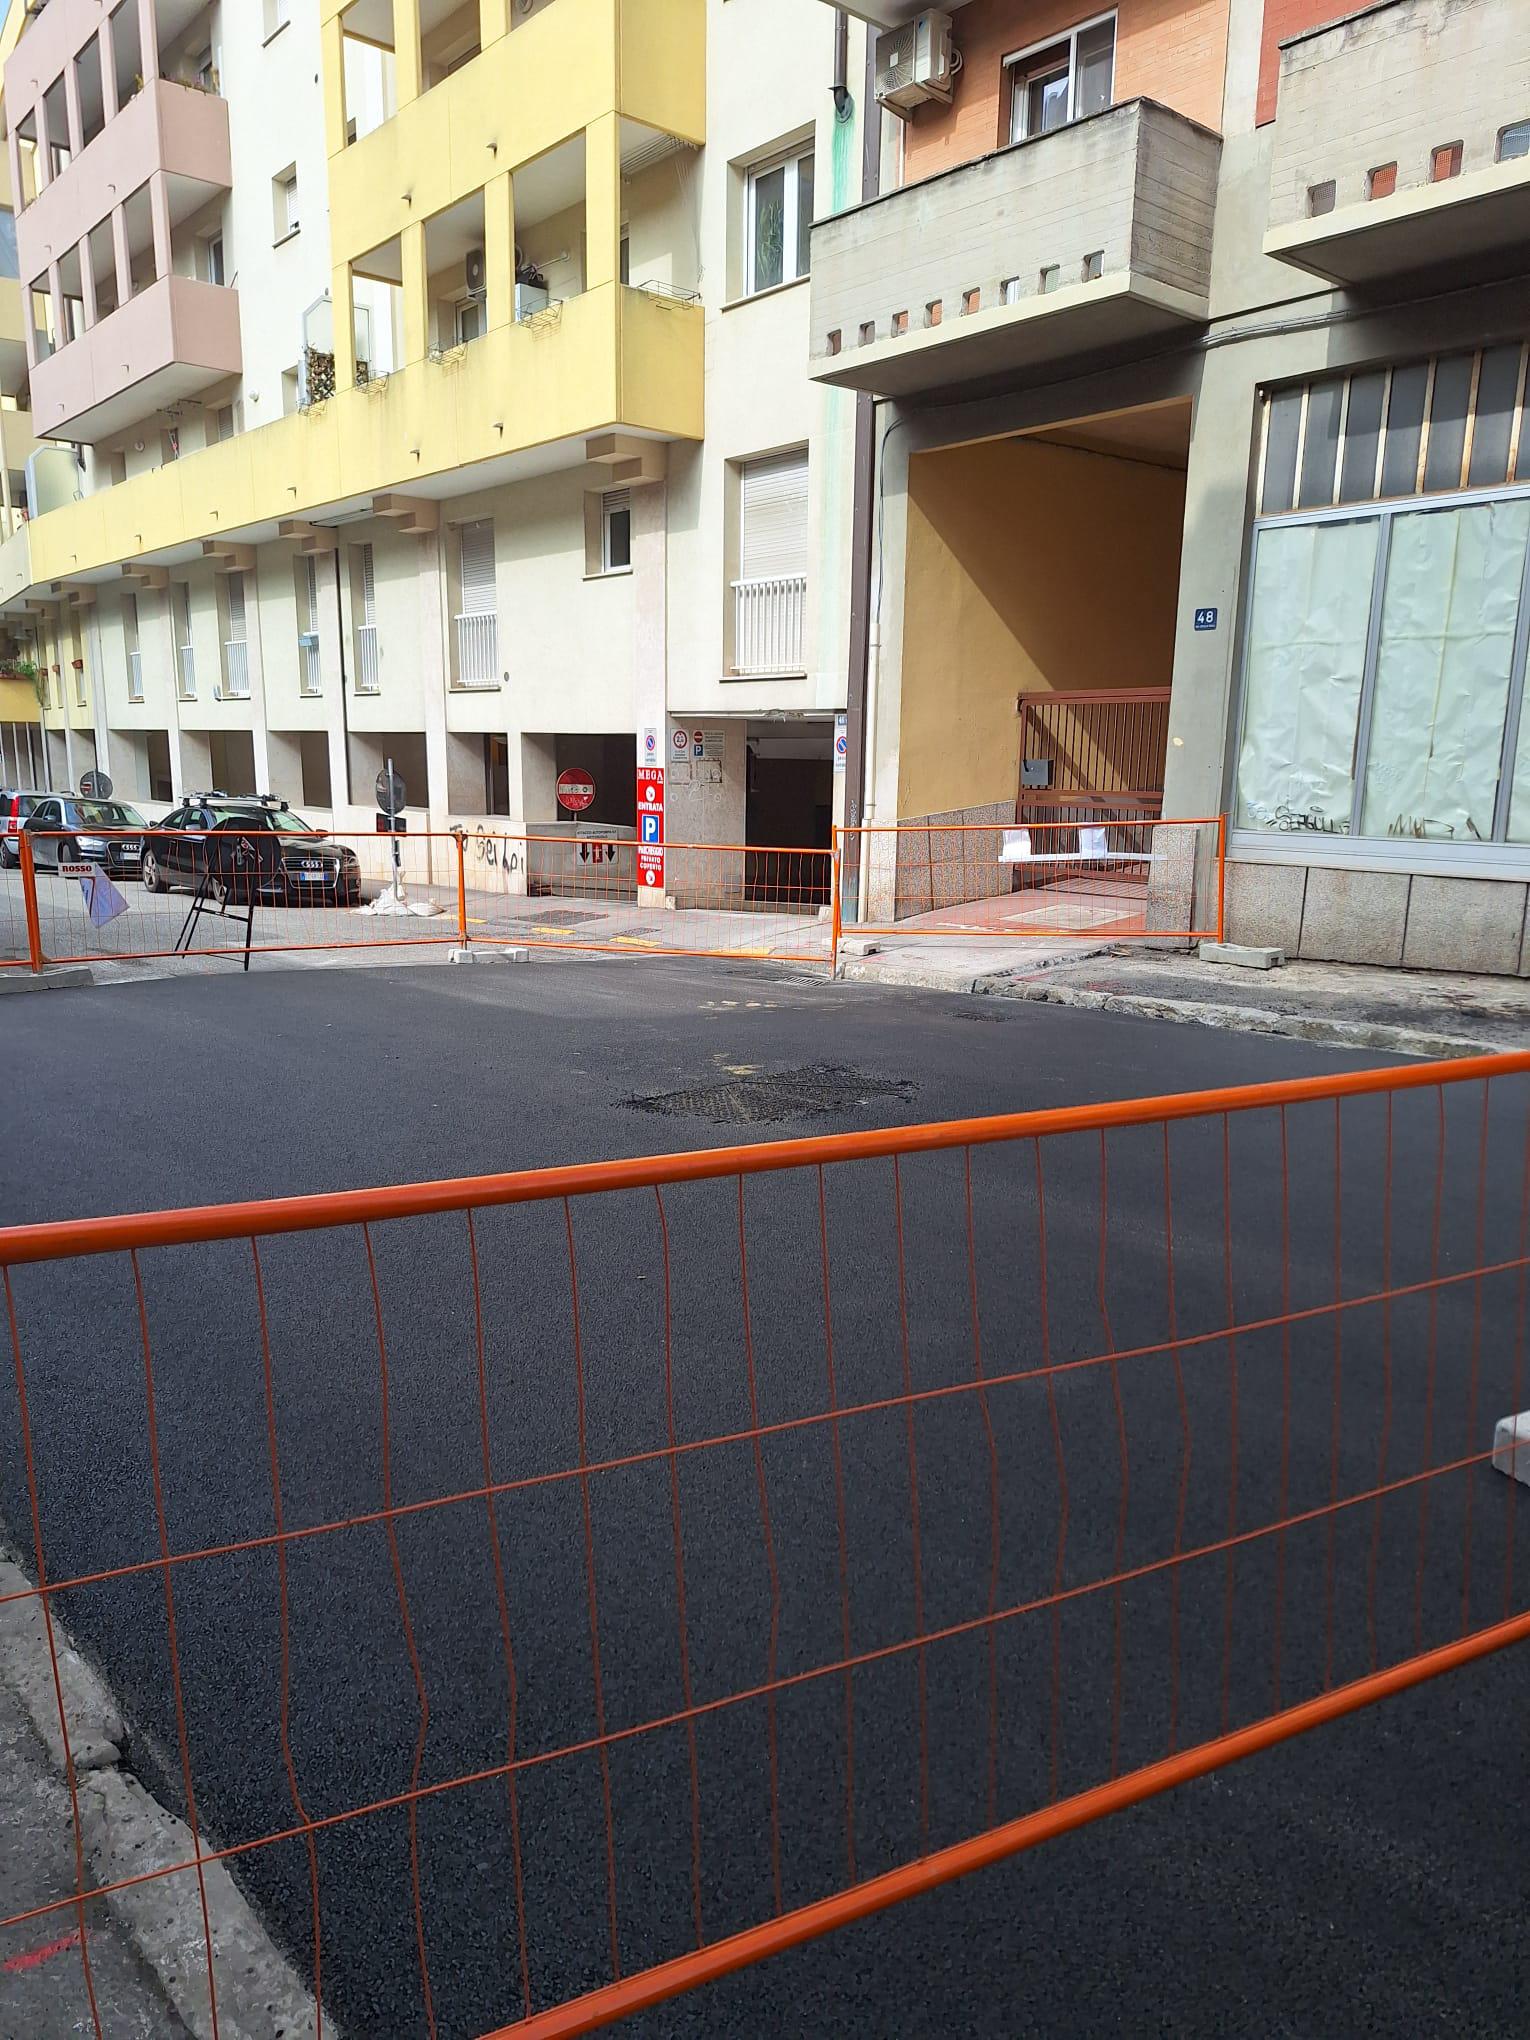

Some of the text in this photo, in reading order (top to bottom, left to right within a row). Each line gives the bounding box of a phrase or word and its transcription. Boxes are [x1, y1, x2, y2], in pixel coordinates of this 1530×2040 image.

[1197, 611, 1214, 624] 48
[695, 746, 702, 756] P
[638, 769, 664, 781] MEGA
[638, 801, 664, 812] ENTRATA
[645, 817, 656, 842] P
